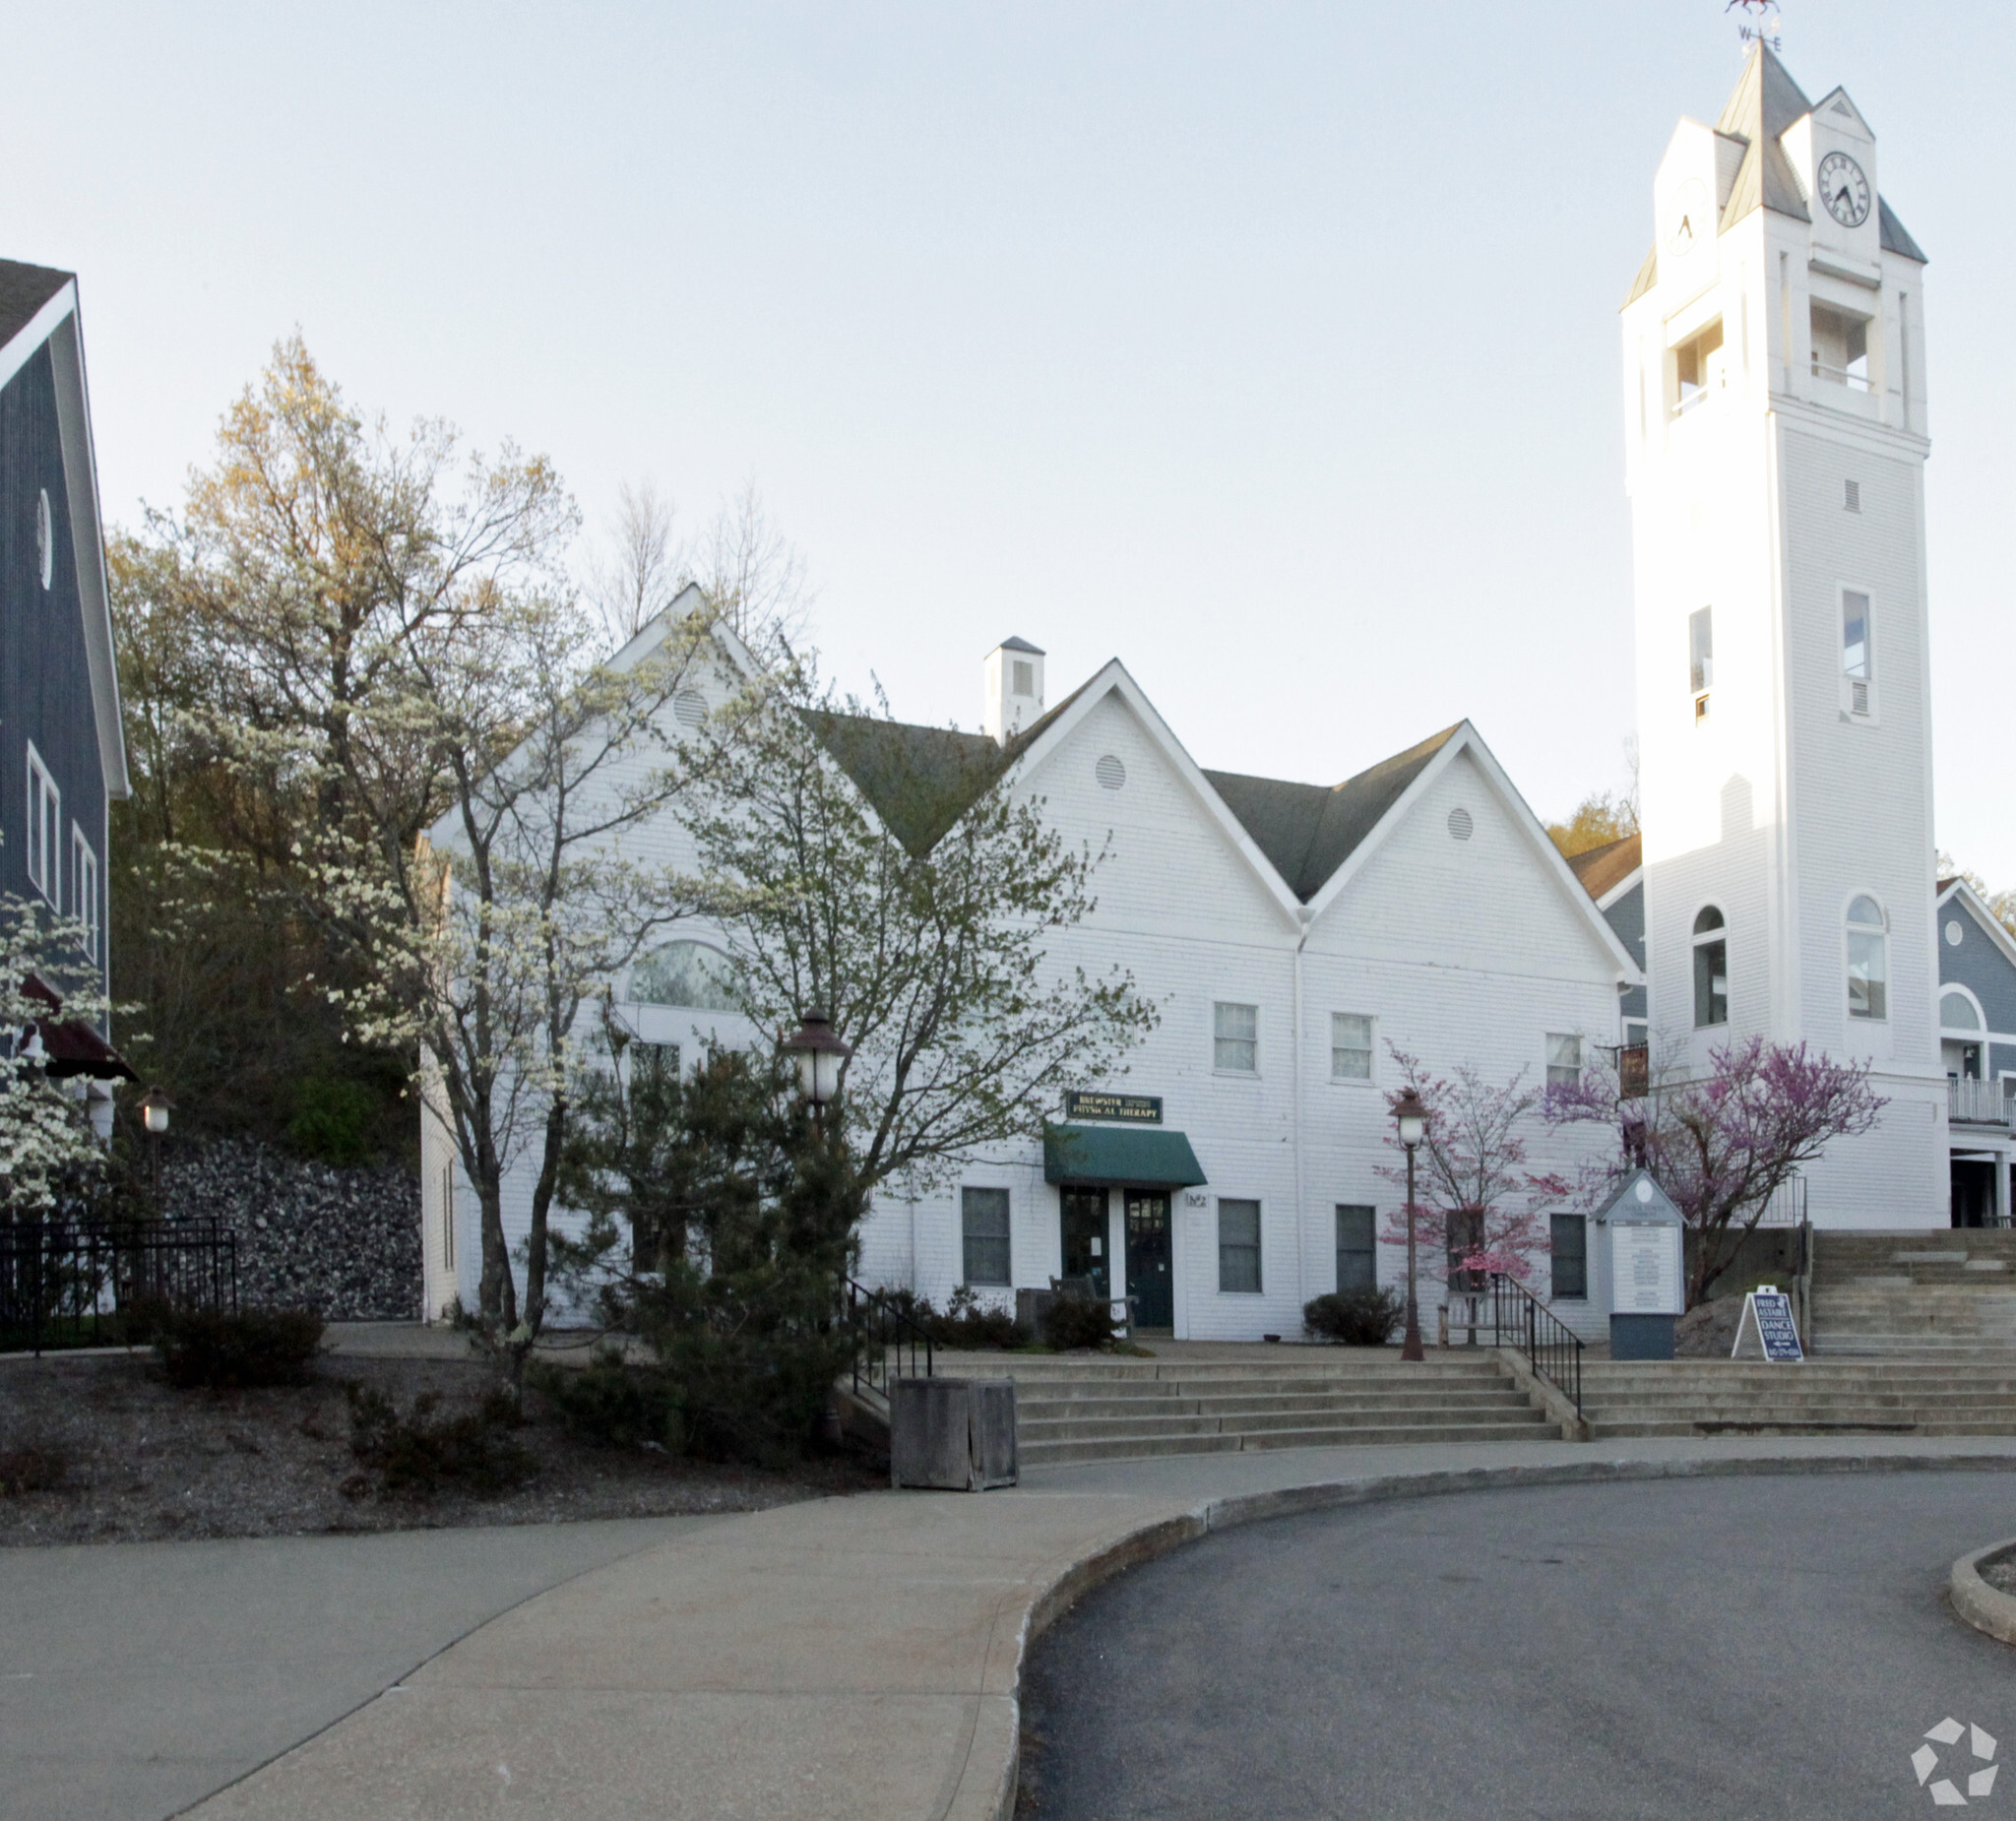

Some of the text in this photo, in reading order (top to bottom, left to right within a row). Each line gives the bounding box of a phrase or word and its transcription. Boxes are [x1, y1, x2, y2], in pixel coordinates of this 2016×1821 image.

[1737, 24, 1751, 40] W
[1774, 36, 1782, 52] E
[1080, 1096, 1121, 1106] BREWSTER
[1073, 1104, 1158, 1118] PHYSICAL THERAPY
[1758, 1308, 1787, 1317] ASTAIRE
[1761, 1321, 1792, 1330] DANCE
[1764, 1331, 1794, 1340] STUDIO
